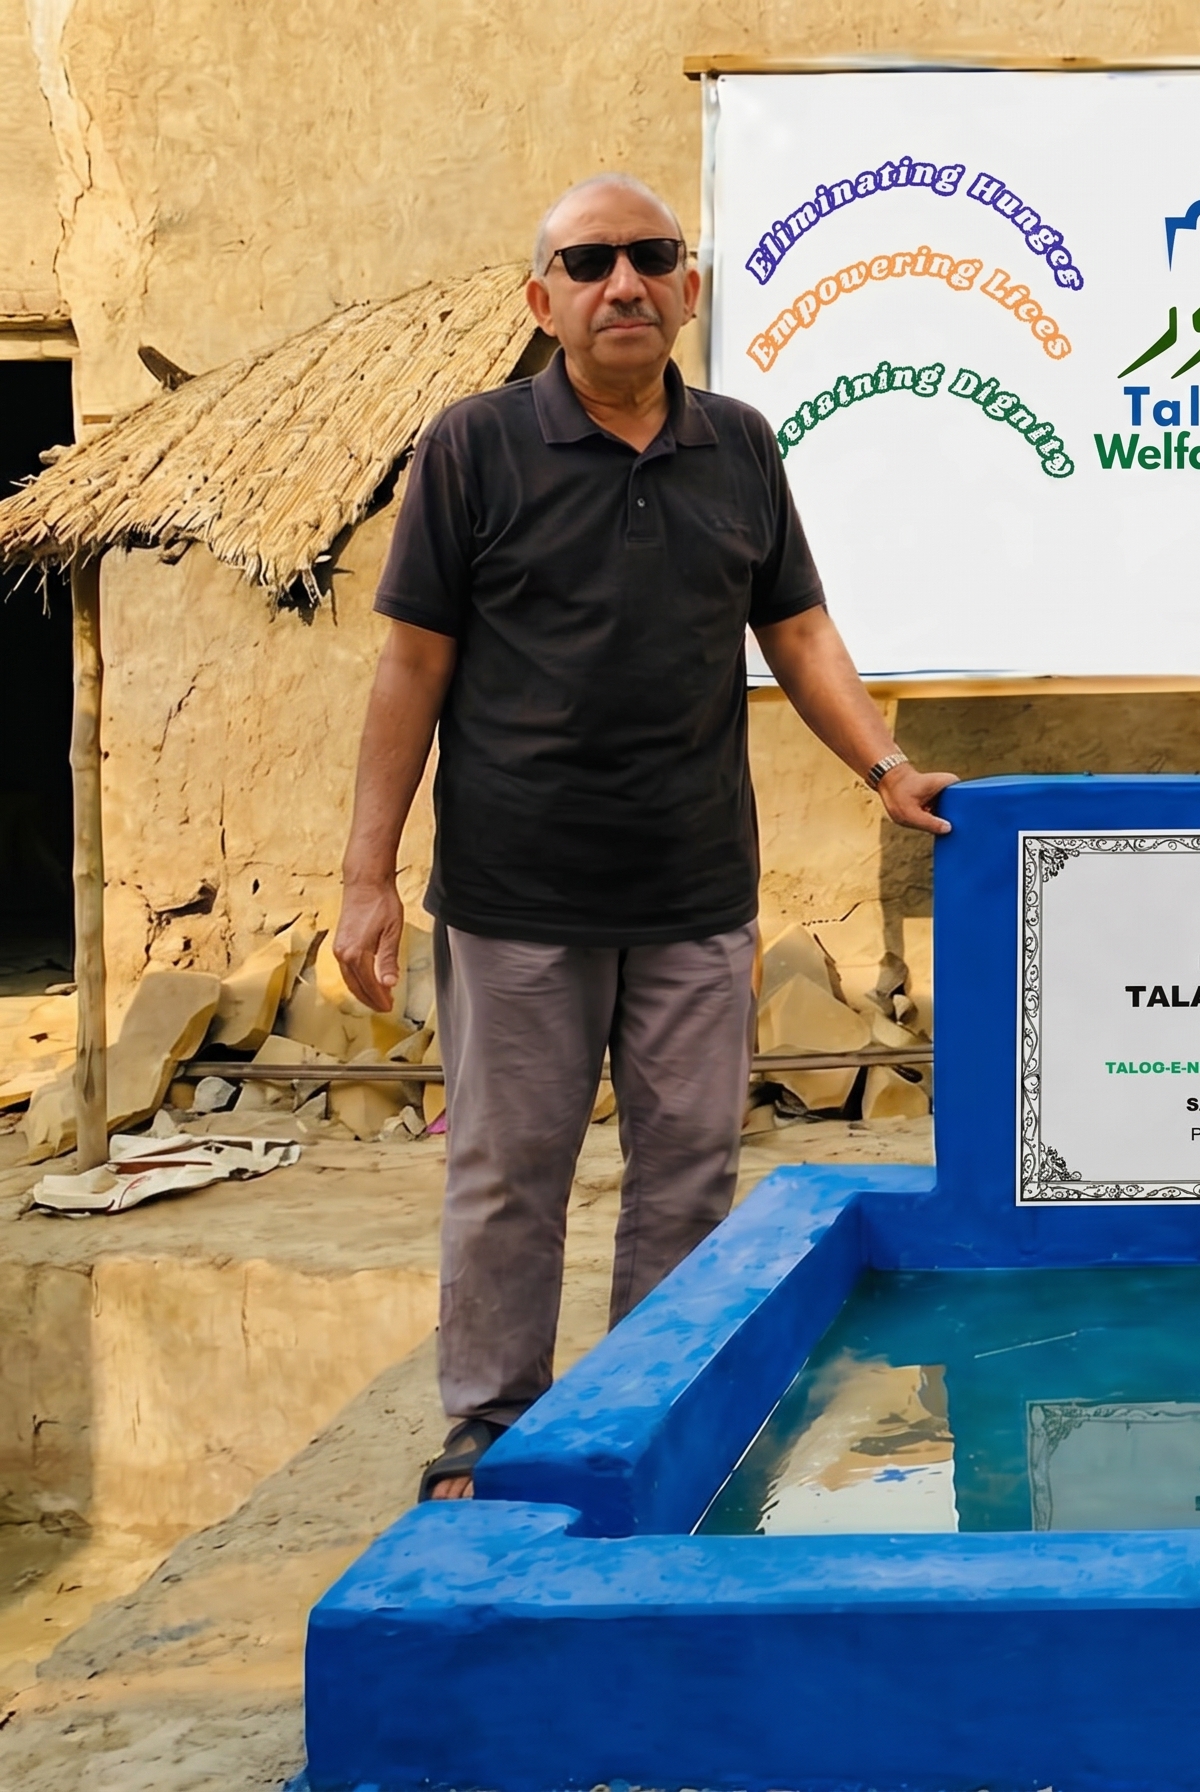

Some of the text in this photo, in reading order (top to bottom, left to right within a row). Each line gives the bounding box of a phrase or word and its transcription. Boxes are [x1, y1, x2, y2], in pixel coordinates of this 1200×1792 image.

[745, 156, 965, 285] Eliminating
[746, 245, 984, 373] Empowering
[948, 368, 1075, 479] Dignity
